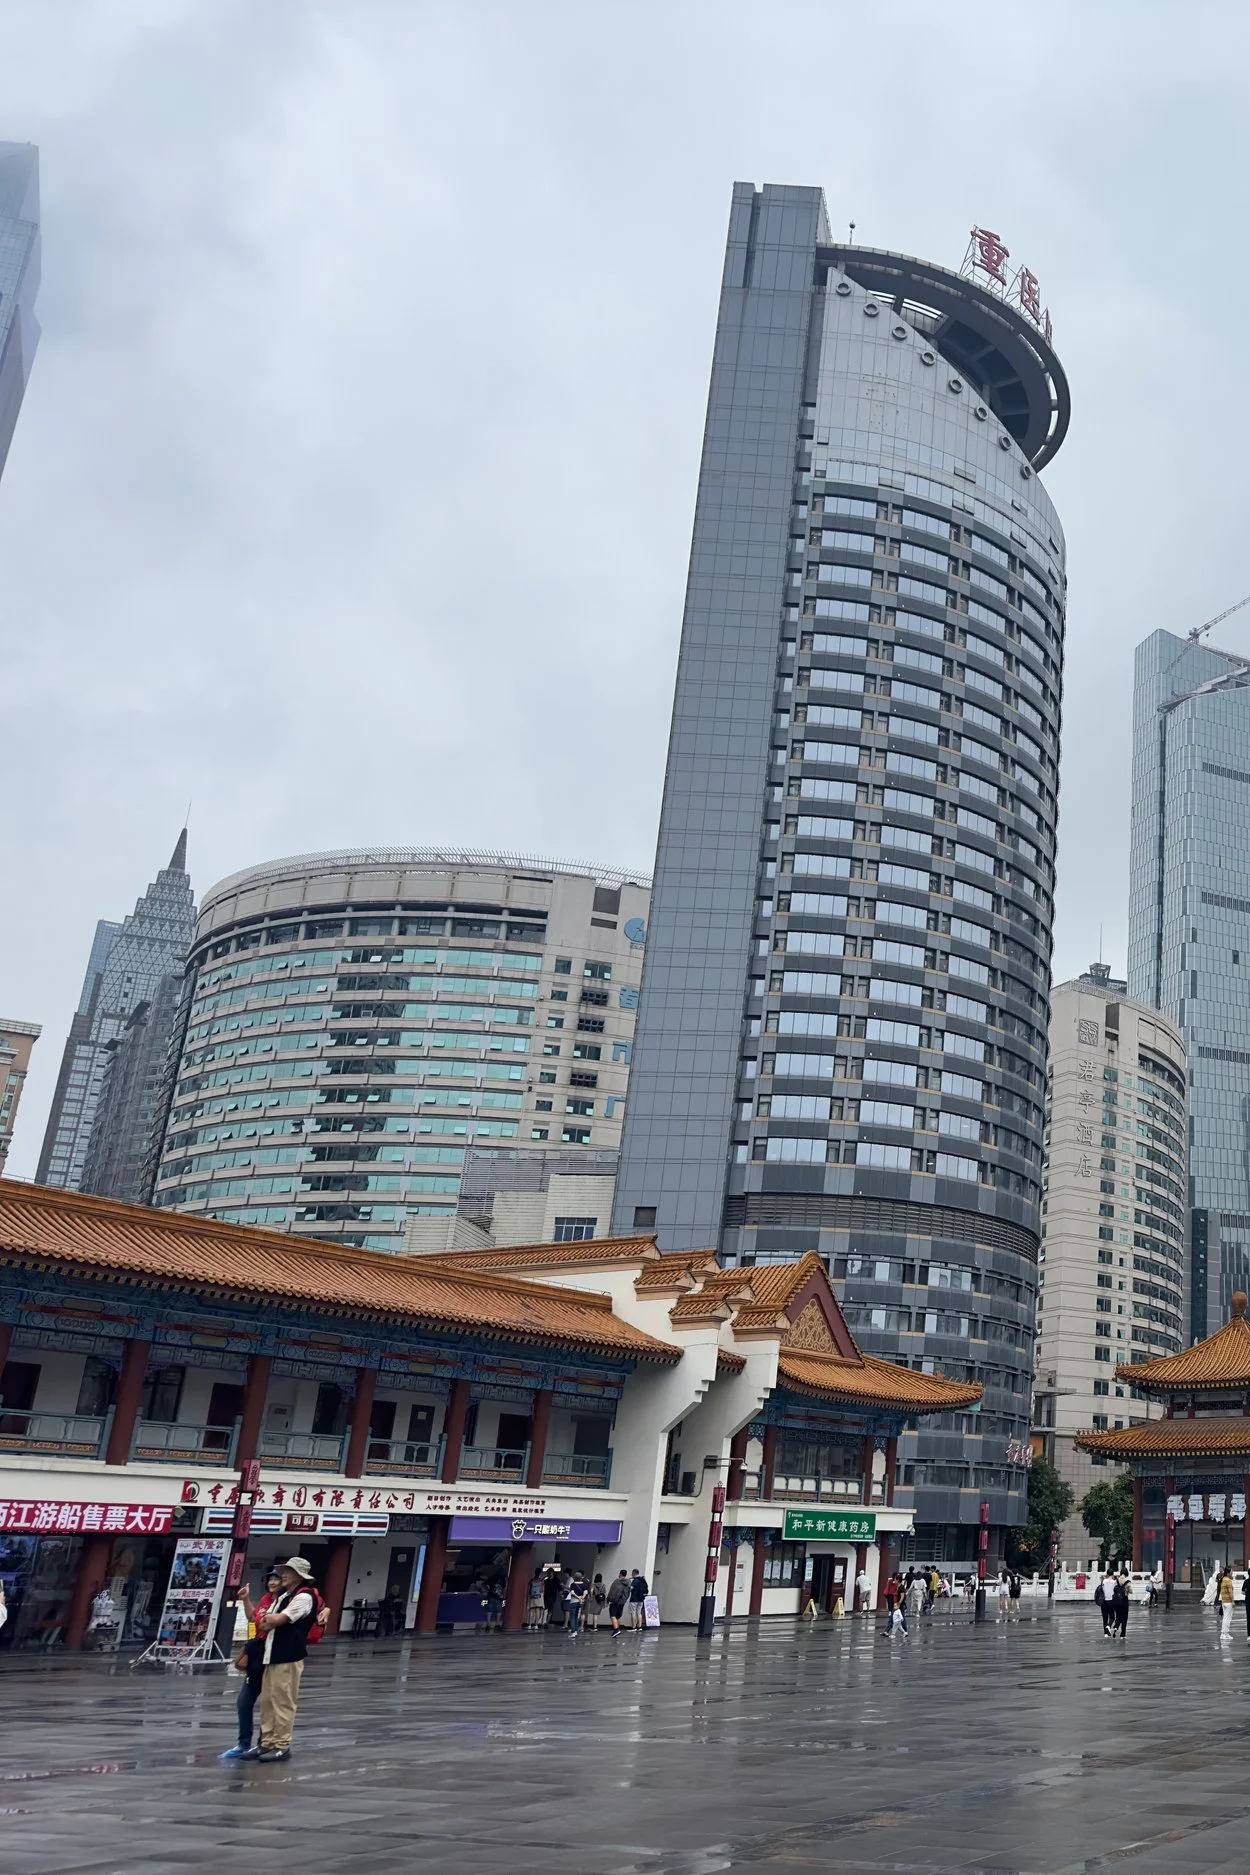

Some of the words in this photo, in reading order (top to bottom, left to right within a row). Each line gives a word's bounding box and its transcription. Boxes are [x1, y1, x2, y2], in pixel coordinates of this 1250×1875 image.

[970, 228, 1053, 346] 重医
[1074, 1060, 1097, 1178] 君亭酒店
[526, 1525, 565, 1534] 一只酸奶牛
[792, 1519, 869, 1533] 和平新健康药房
